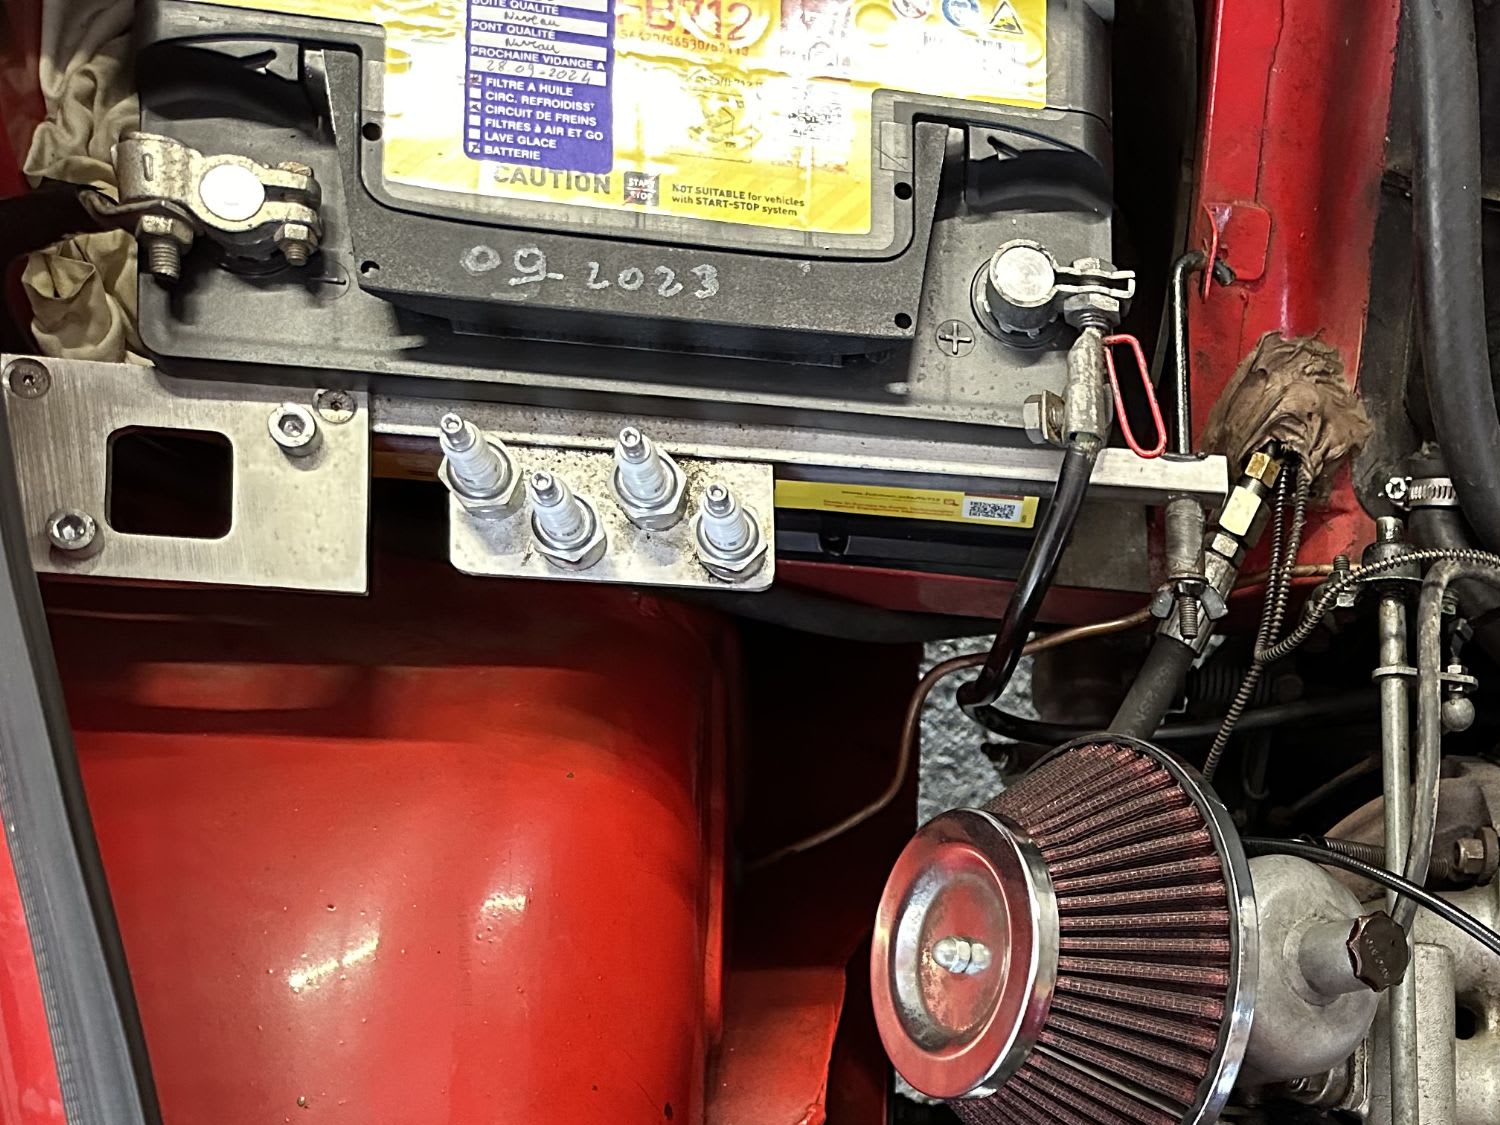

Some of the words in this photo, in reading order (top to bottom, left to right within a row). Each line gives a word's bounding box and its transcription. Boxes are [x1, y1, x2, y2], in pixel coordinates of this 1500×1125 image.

[471, 21, 503, 32] PONT
[471, 46, 539, 62] PROCHAINE
[544, 56, 594, 70] VIDANGE
[597, 62, 605, 70] A
[486, 78, 524, 90] FILTRE
[528, 83, 536, 92] A
[540, 84, 574, 96] HUILE
[486, 91, 518, 104] CIRC.
[486, 105, 532, 119] CIRCUIT
[536, 110, 552, 120] DE
[556, 113, 597, 127] FREINS
[484, 132, 514, 144] LAVE
[517, 135, 557, 148] GLACE
[485, 118, 532, 132] FILTRES
[534, 124, 542, 133] à
[544, 126, 564, 136] AIR
[568, 128, 582, 138] ET
[586, 131, 604, 140] GO
[484, 146, 540, 160] BATTERIE
[494, 166, 611, 195] CAUTION
[672, 184, 693, 194] NOT
[696, 187, 745, 200] SUITABLE
[748, 192, 762, 201] for
[764, 194, 805, 207] vehicles
[672, 195, 694, 205] with
[696, 197, 760, 212] START-STOP
[762, 204, 798, 217] system
